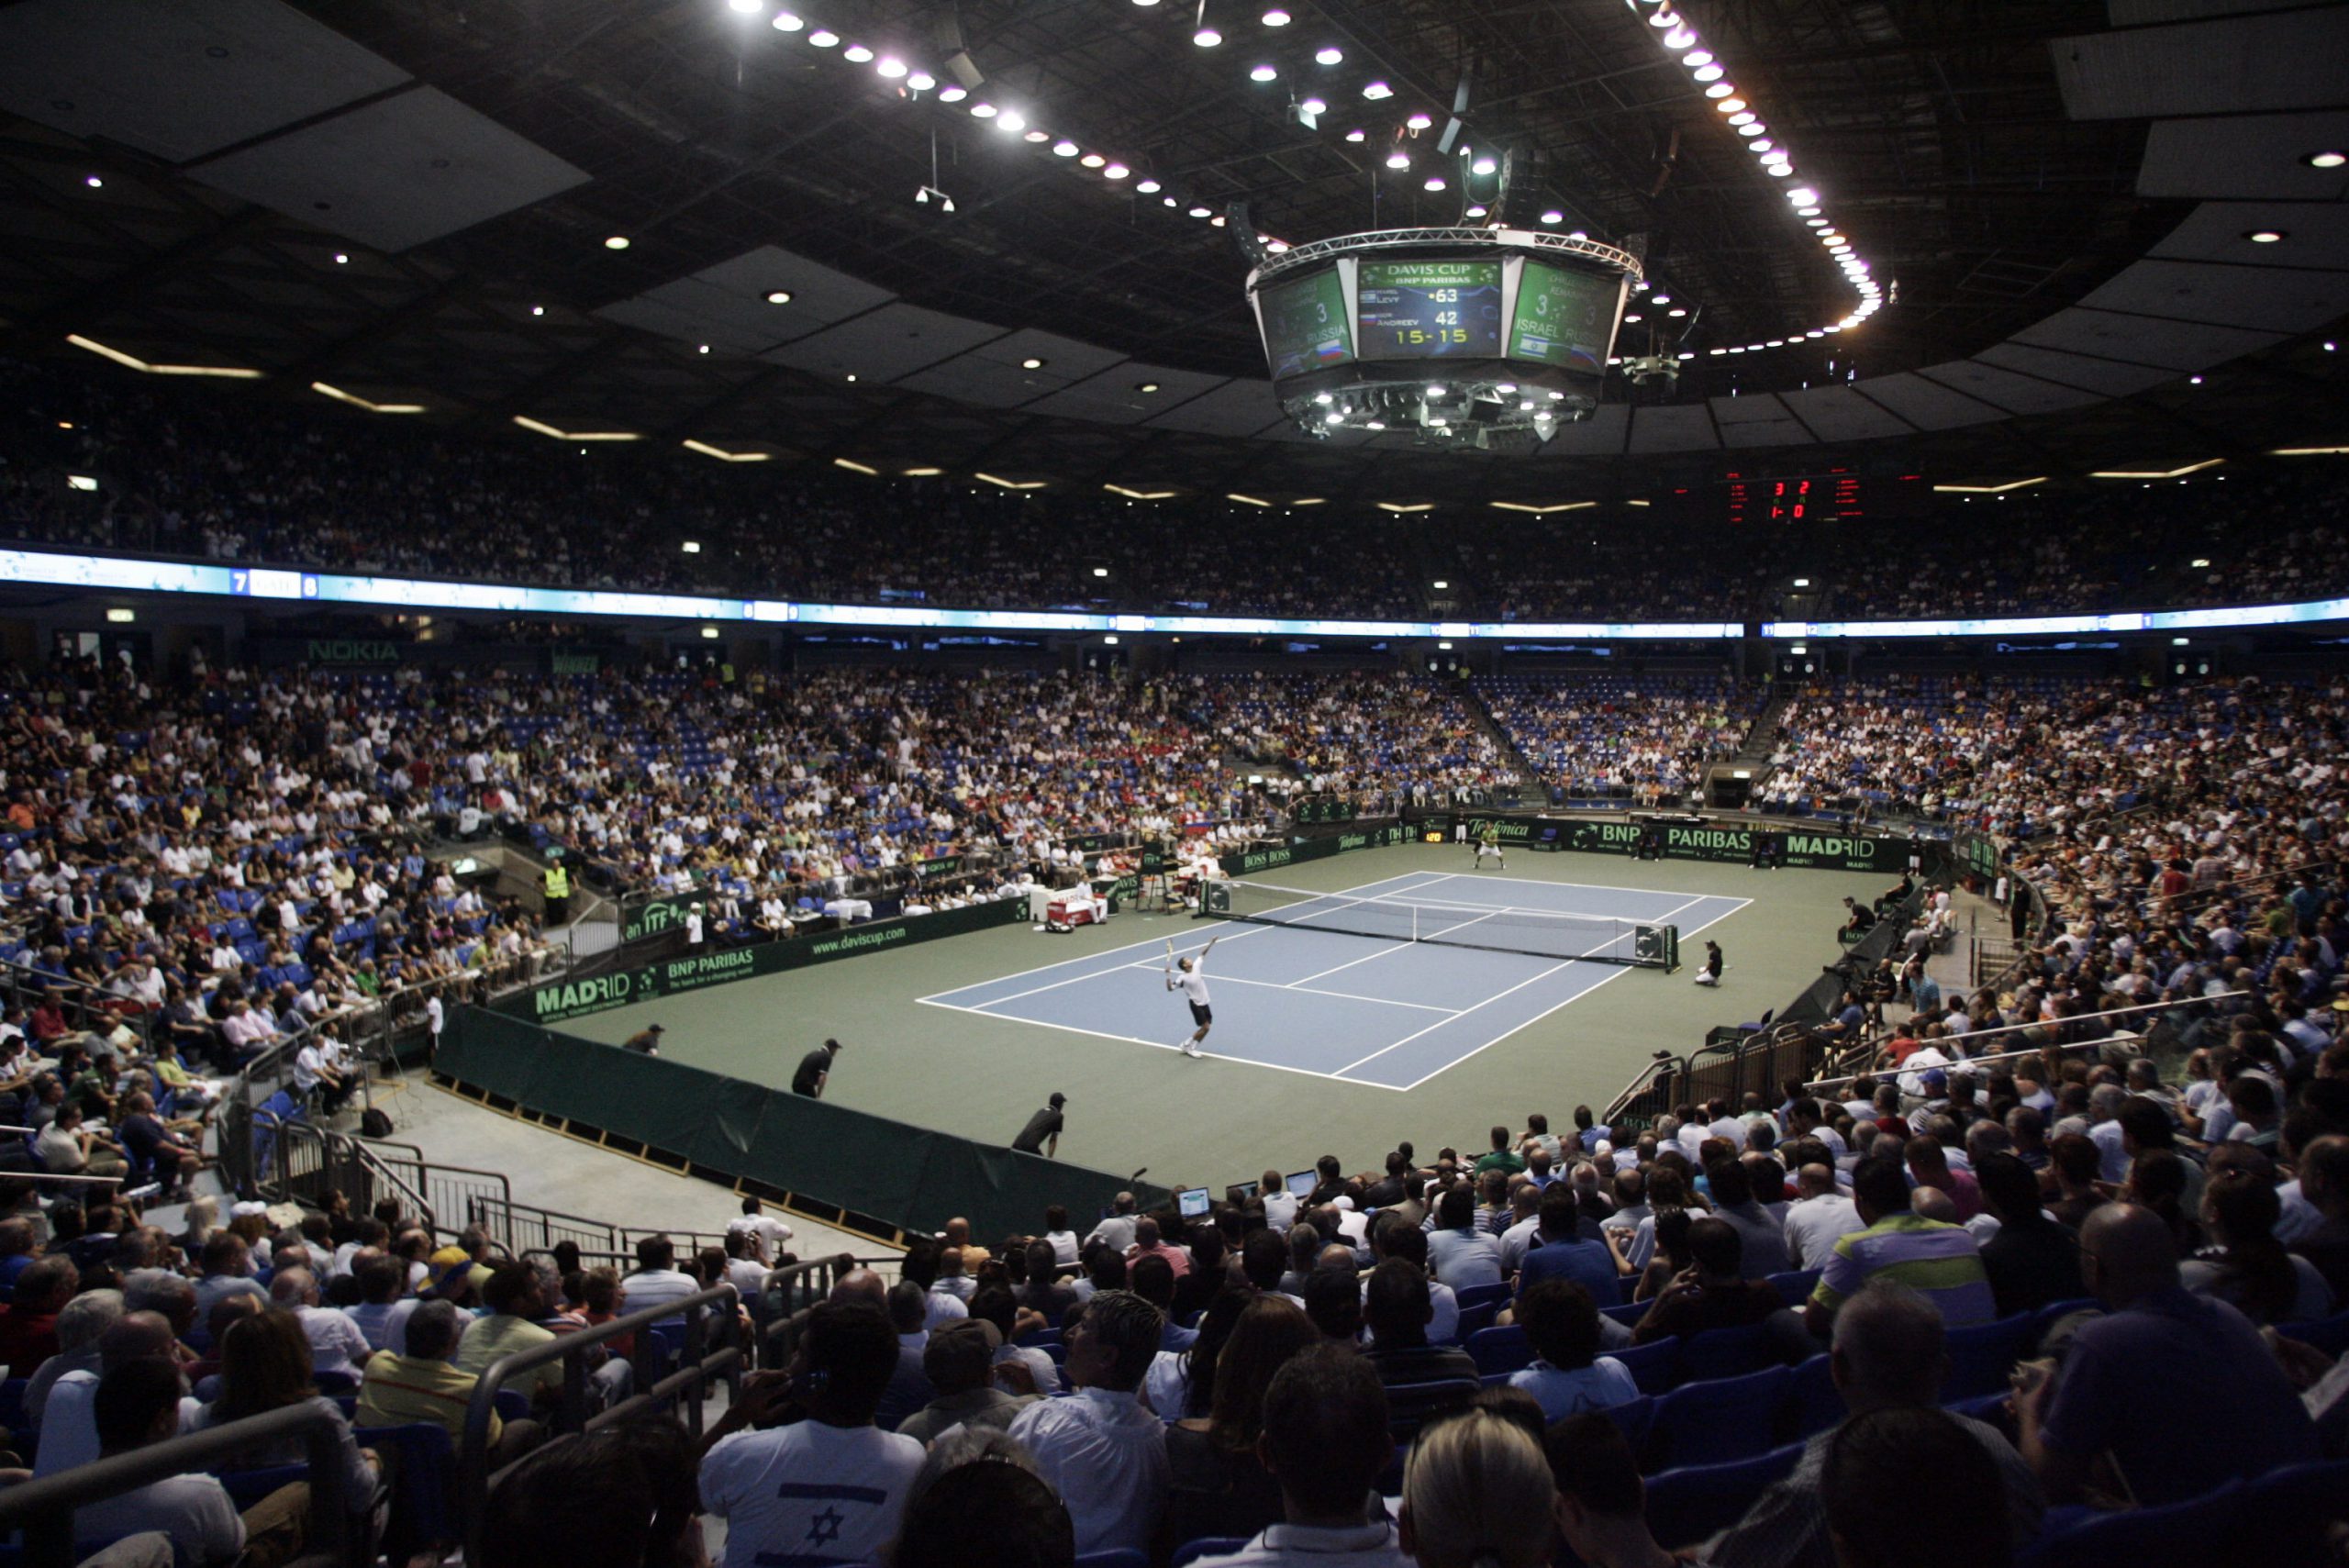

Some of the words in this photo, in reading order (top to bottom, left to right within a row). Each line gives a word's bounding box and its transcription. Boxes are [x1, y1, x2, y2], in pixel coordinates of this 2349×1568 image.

[1387, 265, 1433, 275] DAVIS
[1438, 264, 1471, 274] CUP
[1422, 276, 1471, 284] PARIBAS
[1436, 288, 1458, 303] 63
[1536, 294, 1548, 317] 3
[1317, 303, 1328, 323] 3
[1435, 310, 1458, 326] 42
[1307, 324, 1347, 344] RUSSIA
[1516, 317, 1559, 339] ISRAEL
[1775, 482, 1785, 496] 3
[1798, 481, 1809, 495] 2
[1793, 504, 1804, 518] 0
[233, 572, 247, 593] 7
[304, 576, 317, 597] 8
[1469, 625, 1479, 636] 11
[1763, 624, 1774, 635] 11
[1806, 624, 1818, 635] 12
[307, 639, 398, 661] NOKIA
[1602, 825, 1642, 843] BNP
[1668, 828, 1751, 850] PARIBAS
[1787, 836, 1875, 858] MADRID
[1244, 851, 1267, 868] BOSS
[1269, 848, 1291, 863] BOSS
[626, 922, 641, 940] an
[644, 910, 669, 934] ITF
[813, 927, 907, 954] www.daviscup.com
[668, 961, 697, 979] BNP
[699, 949, 753, 973] PARIBAS
[536, 973, 630, 1015] MADRID
